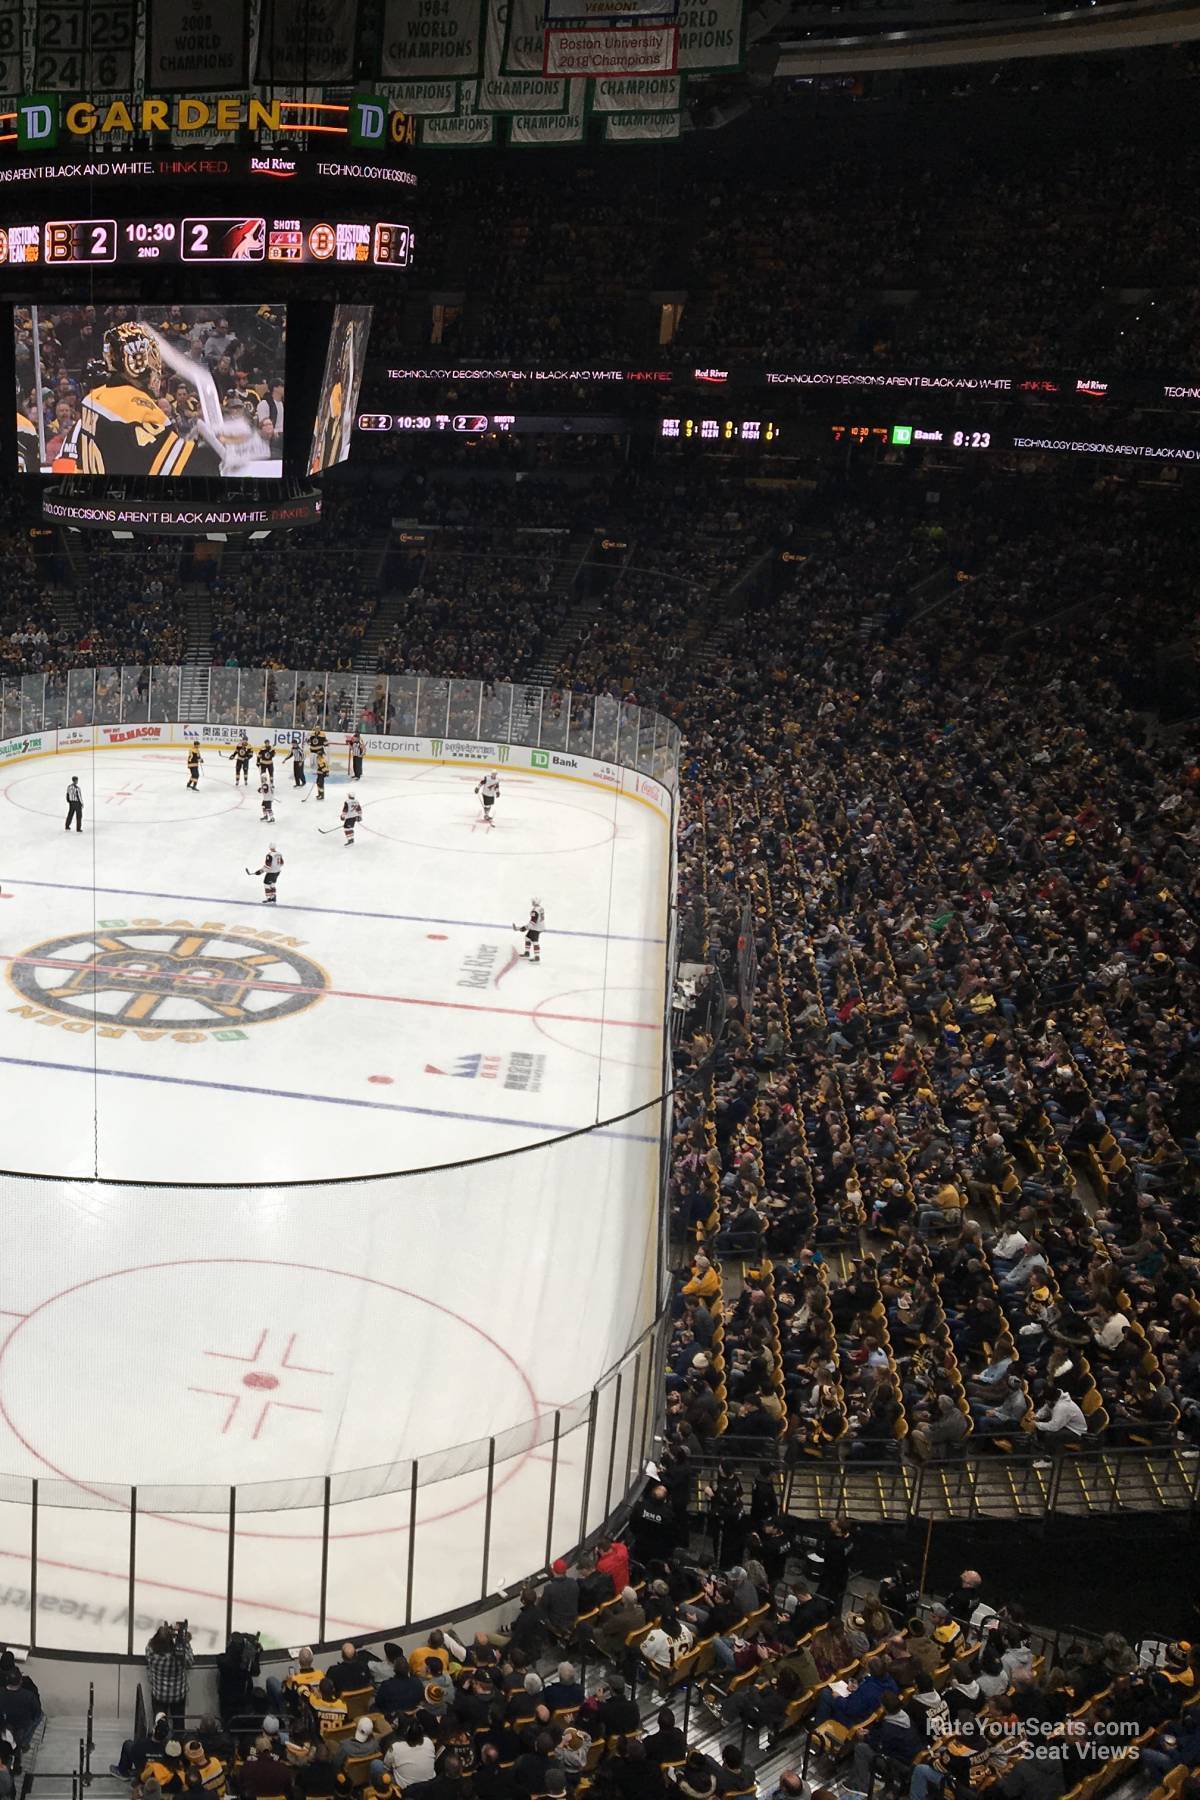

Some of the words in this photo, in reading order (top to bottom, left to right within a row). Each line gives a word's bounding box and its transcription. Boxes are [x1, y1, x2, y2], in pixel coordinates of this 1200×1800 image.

[418, 1, 449, 18] 1984
[42, 14, 78, 47] 21
[90, 11, 129, 43] 25
[407, 21, 458, 37] WORLD
[175, 34, 221, 50] WORLD
[388, 41, 472, 59] CHAMPIONS
[560, 37, 601, 50] Boston
[605, 36, 663, 50] University
[159, 53, 234, 71] CHAMPIONS
[560, 56, 588, 68] 2018
[589, 54, 660, 68] Champions
[39, 55, 79, 88] 24
[99, 55, 117, 87] 6
[378, 83, 451, 99] CHAMPIONS
[486, 80, 560, 95] CHAMPIONS
[600, 78, 676, 95] CHAMPIONS
[65, 99, 281, 135] GARDEN
[427, 118, 488, 132] CHAMPIONS
[516, 115, 580, 129] CHAMPIONS
[611, 113, 676, 126] CHAMPIONS
[45, 163, 82, 178] BLACK
[83, 162, 110, 176] AND
[251, 157, 270, 170] Red
[271, 157, 296, 170] River
[316, 162, 383, 179] TECHNOLOGY
[126, 223, 175, 243] 10:30
[273, 220, 301, 230] SHOTS
[90, 227, 108, 255] 2
[191, 224, 209, 251] 2
[137, 247, 160, 258] 2ND
[336, 242, 356, 261] TEAM
[535, 370, 569, 380] BLACK
[694, 368, 708, 378] Red
[709, 368, 729, 378] River
[766, 373, 835, 385] TECHNOLOGY
[835, 374, 885, 386] DECISIONS
[921, 377, 955, 388] BLACK
[955, 379, 978, 389] AND
[1076, 380, 1090, 390] Red
[1090, 381, 1108, 391] River
[378, 416, 387, 428] 2
[397, 416, 431, 429] 10:30
[457, 417, 467, 429] 2
[662, 418, 681, 428] DET
[685, 428, 693, 437] 3
[913, 429, 944, 442] Bank
[952, 430, 992, 449] 8:23
[1013, 438, 1072, 451] TECHNOLOGY
[1072, 442, 1116, 455] DECISIONS
[1145, 448, 1176, 458] BLACK
[1176, 449, 1195, 460] AND
[67, 504, 117, 522] DECISIONS
[117, 510, 160, 524] AREN'T
[160, 511, 203, 525] BLACK
[204, 511, 232, 524] AND
[273, 730, 306, 746] jetBl
[552, 756, 579, 769] Bank
[130, 917, 310, 949] GARDEN
[464, 944, 499, 968] River
[457, 968, 491, 989] Red
[7, 1004, 209, 1044] GARDEN
[111, 1606, 220, 1648] Ley
